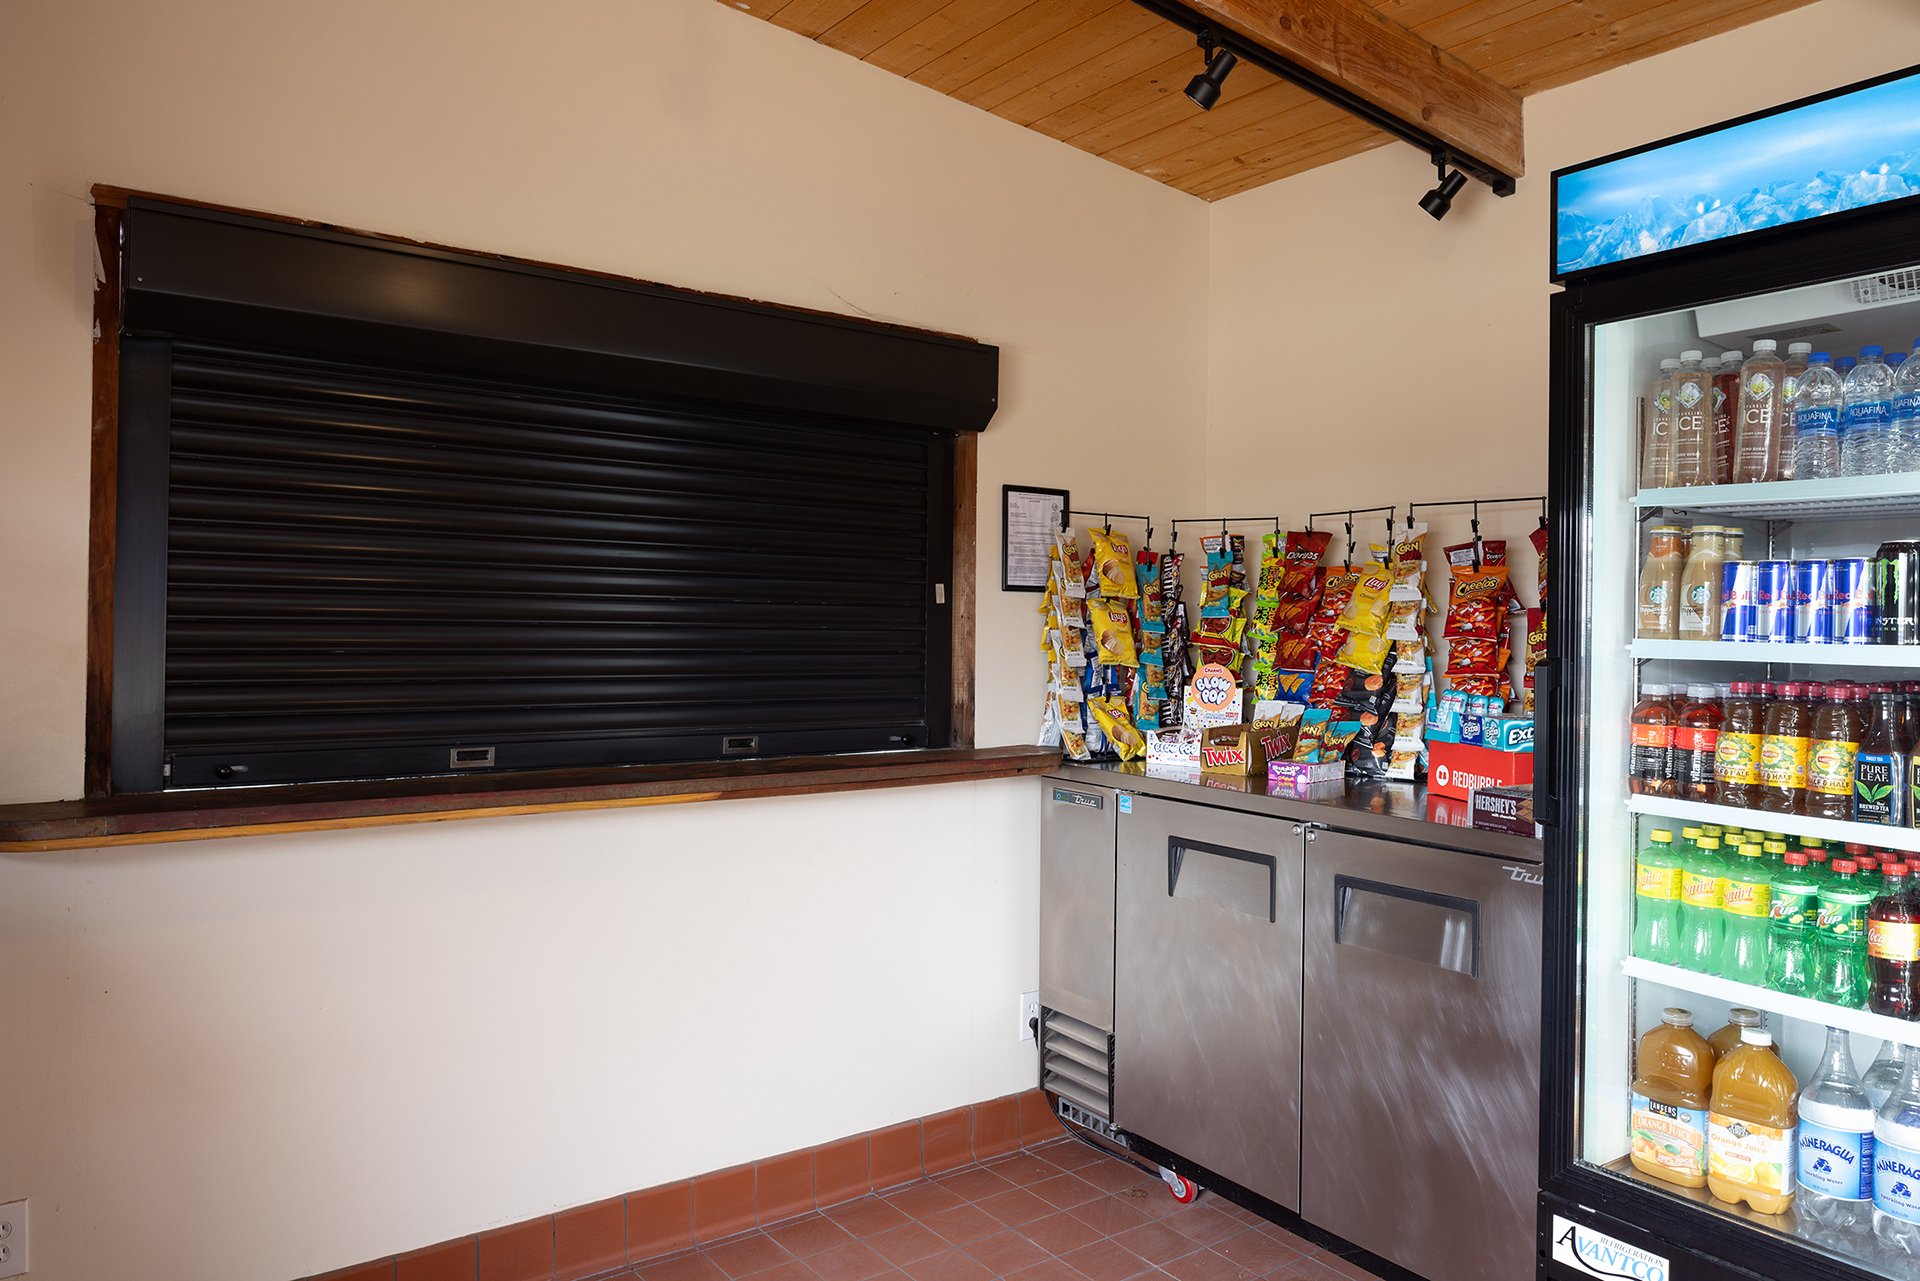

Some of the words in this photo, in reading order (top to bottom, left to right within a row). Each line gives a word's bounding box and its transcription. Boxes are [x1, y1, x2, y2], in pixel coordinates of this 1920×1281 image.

[1743, 409, 1769, 424] ICE
[1798, 410, 1834, 423] QUAFINA
[1849, 405, 1889, 417] AQUAFINA
[1652, 421, 1669, 436] IC
[1676, 416, 1703, 431] ICE
[1286, 551, 1320, 560] Doritos
[1396, 541, 1420, 555] CORN
[1208, 569, 1227, 582] CORN
[1456, 577, 1500, 598] Cheetos
[1196, 676, 1232, 692] BLOW
[1201, 688, 1228, 705] POP
[1860, 764, 1888, 774] PURE
[1475, 795, 1517, 816] HERSHEY'S
[1858, 803, 1880, 811] BREWED
[1502, 865, 1544, 886] tru
[1711, 1133, 1743, 1148] Orange
[1744, 1143, 1768, 1155] Juice
[1800, 1136, 1855, 1165] MINERAGUA
[1803, 1168, 1826, 1182] Sparkling
[1826, 1177, 1844, 1185] Water
[1876, 1160, 1920, 1180] MINERAG
[1880, 1192, 1905, 1207] Sparkling
[1905, 1202, 1920, 1210] Wate
[1600, 1236, 1665, 1267] REFRIGERATION
